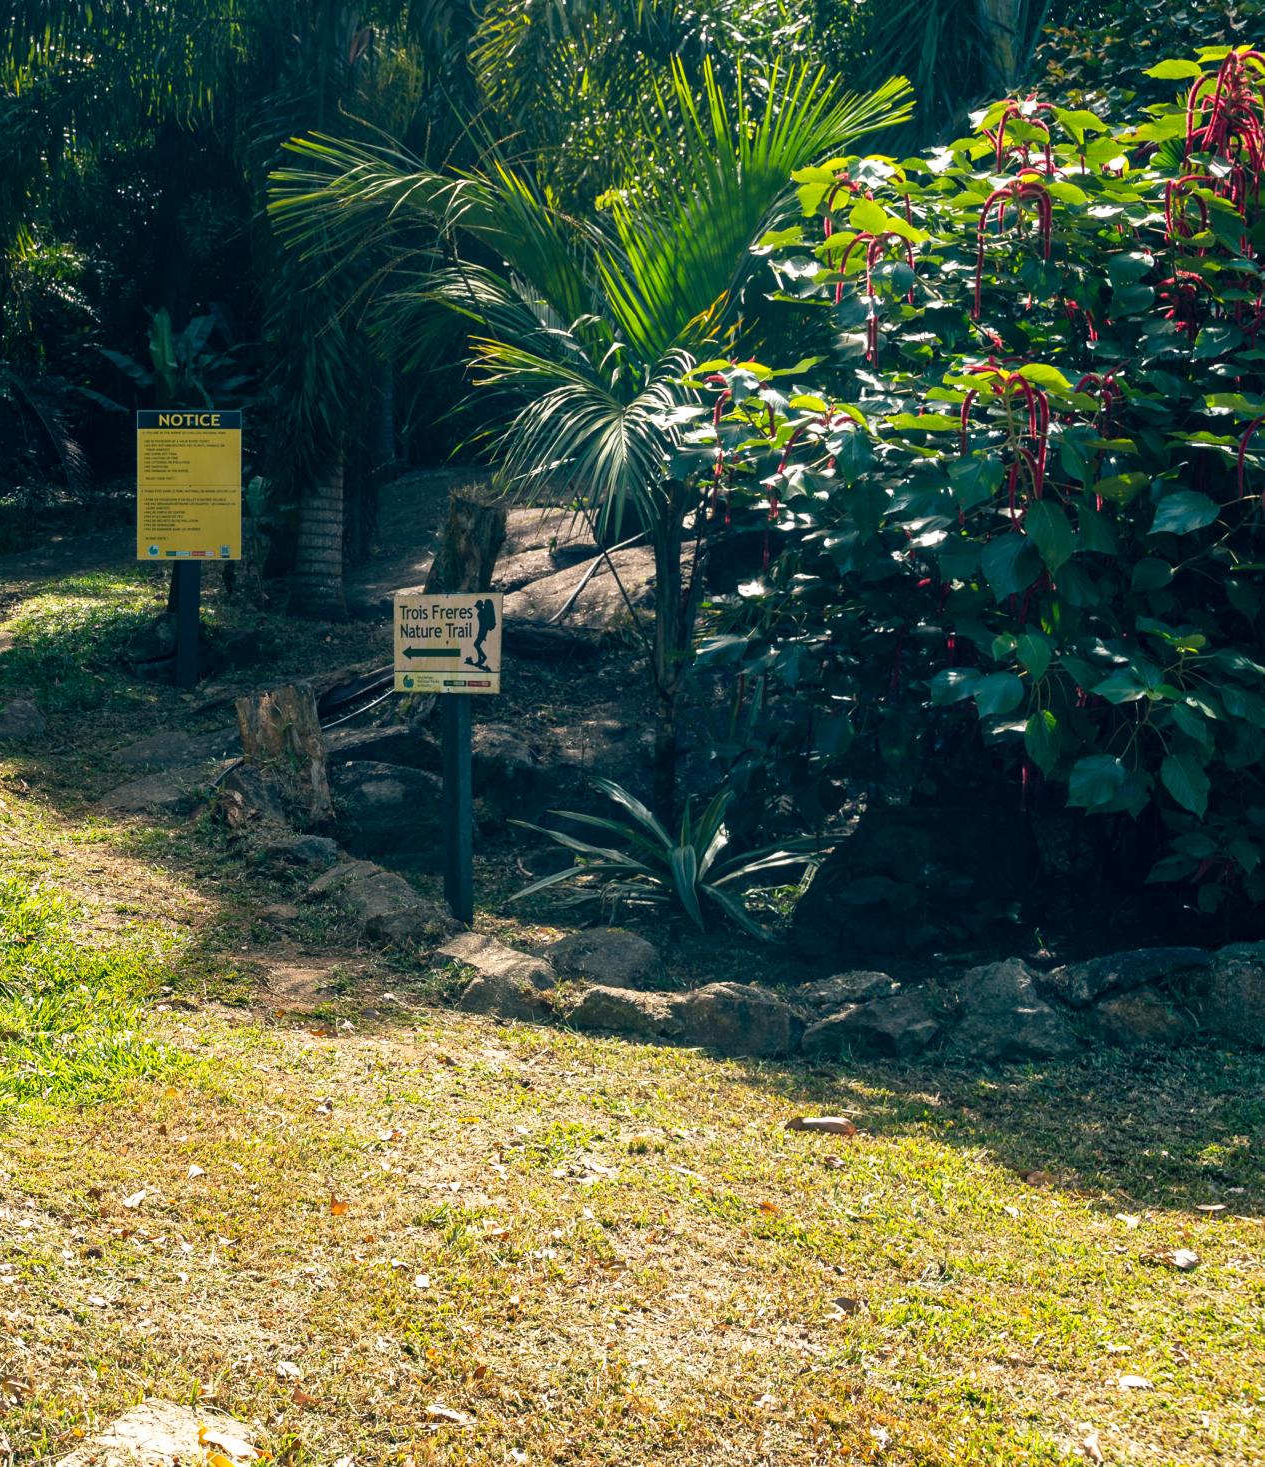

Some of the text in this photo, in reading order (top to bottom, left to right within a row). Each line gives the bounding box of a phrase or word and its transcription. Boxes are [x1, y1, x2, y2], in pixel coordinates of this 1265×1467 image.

[158, 414, 221, 427] NOTICE
[399, 605, 473, 620] Trois Freres
[400, 623, 472, 638] Nature Trail
